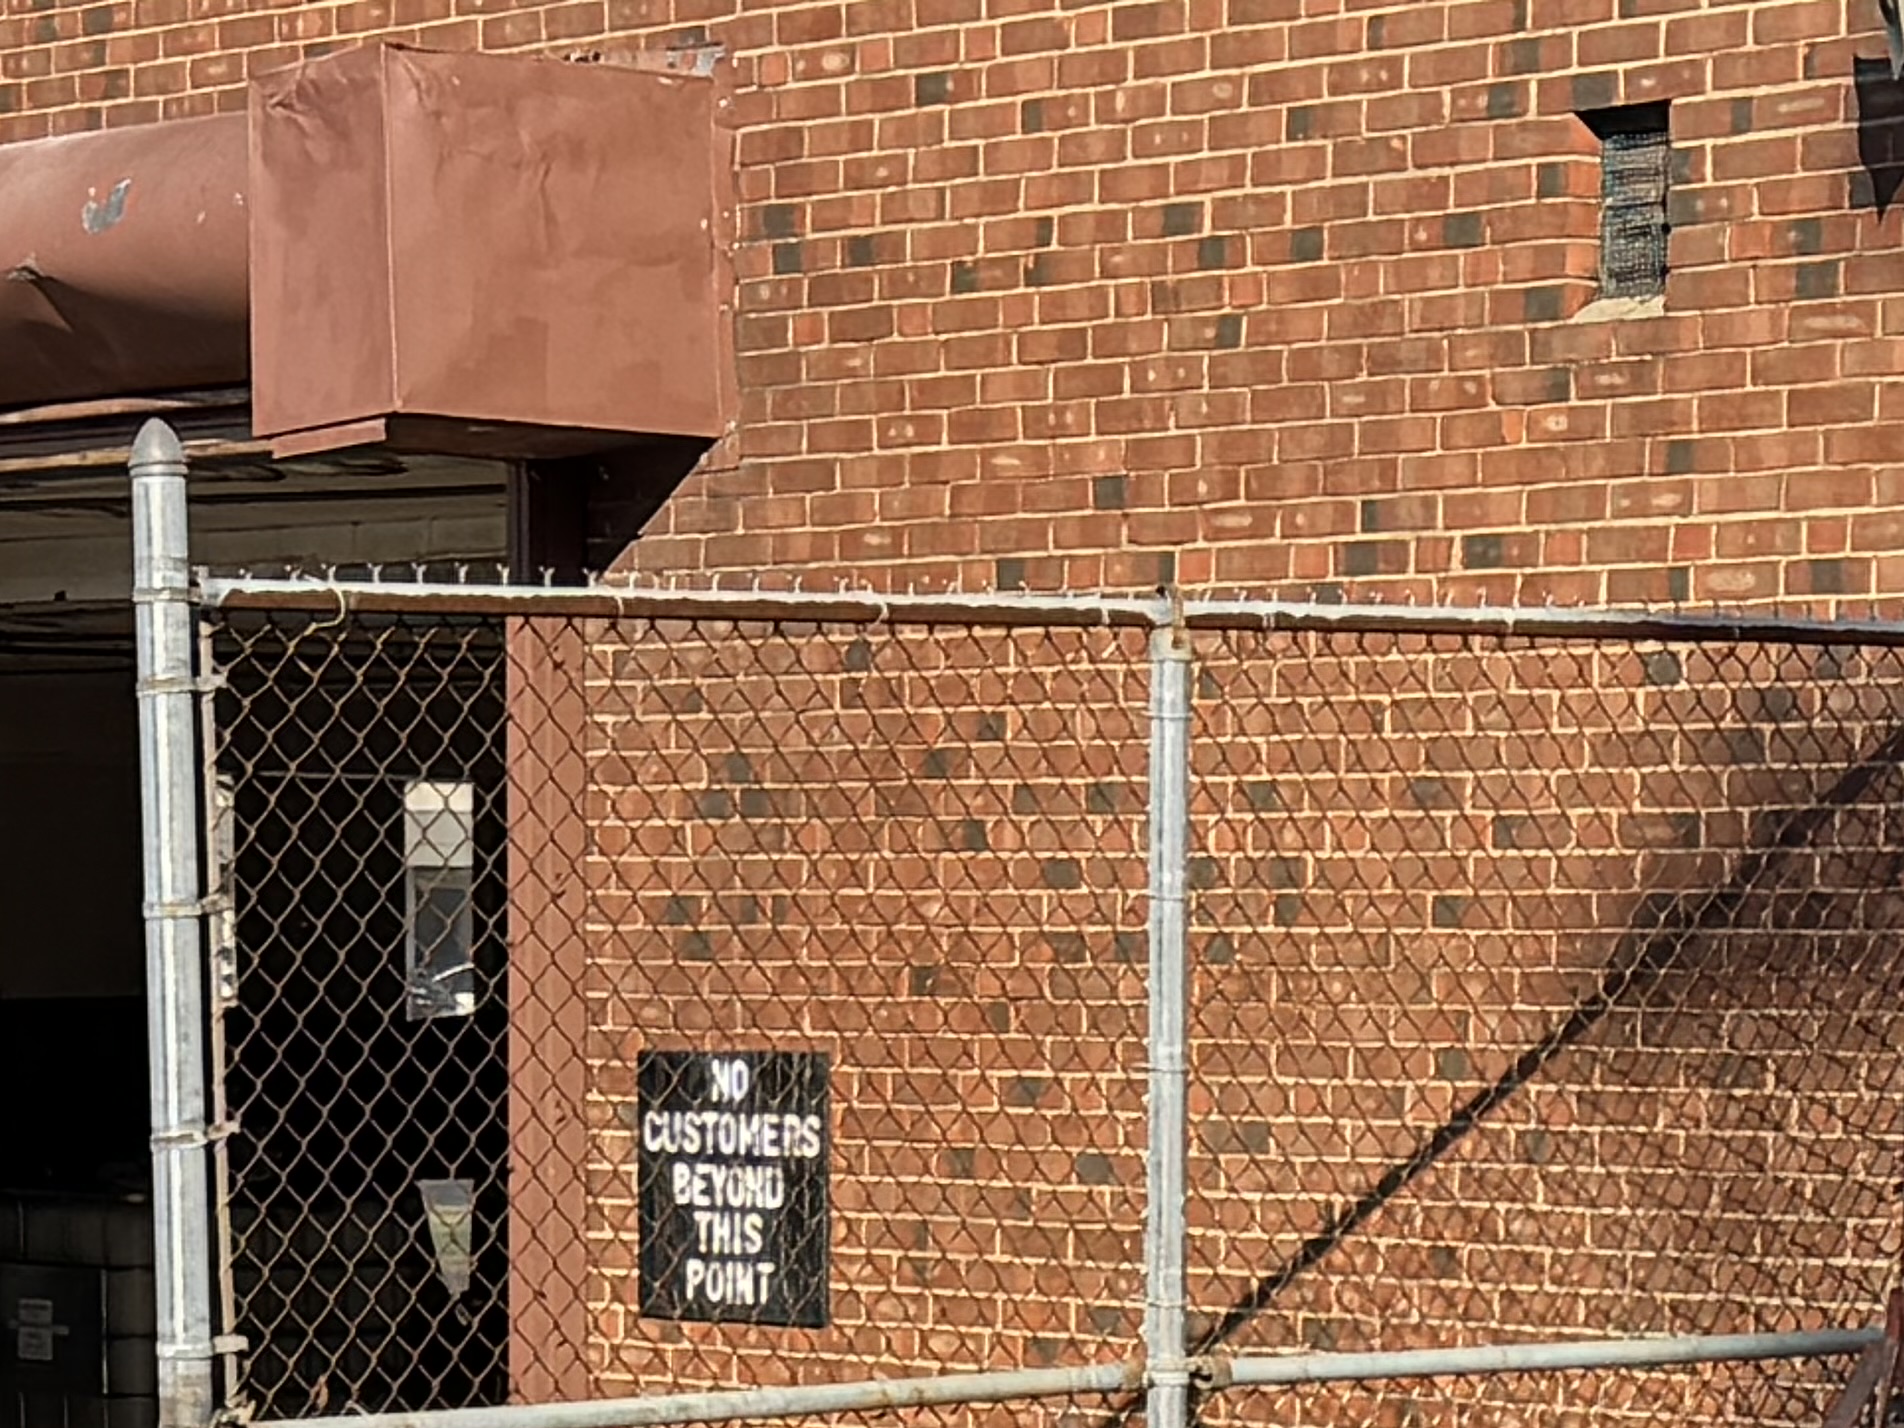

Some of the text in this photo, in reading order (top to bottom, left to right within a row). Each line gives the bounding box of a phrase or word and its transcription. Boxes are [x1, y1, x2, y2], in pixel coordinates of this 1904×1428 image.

[712, 1058, 750, 1102] NO
[644, 1111, 822, 1158] CUSTOMERS
[672, 1161, 785, 1209] BEYOND
[693, 1211, 764, 1255] THIS
[686, 1258, 775, 1305] POINT
